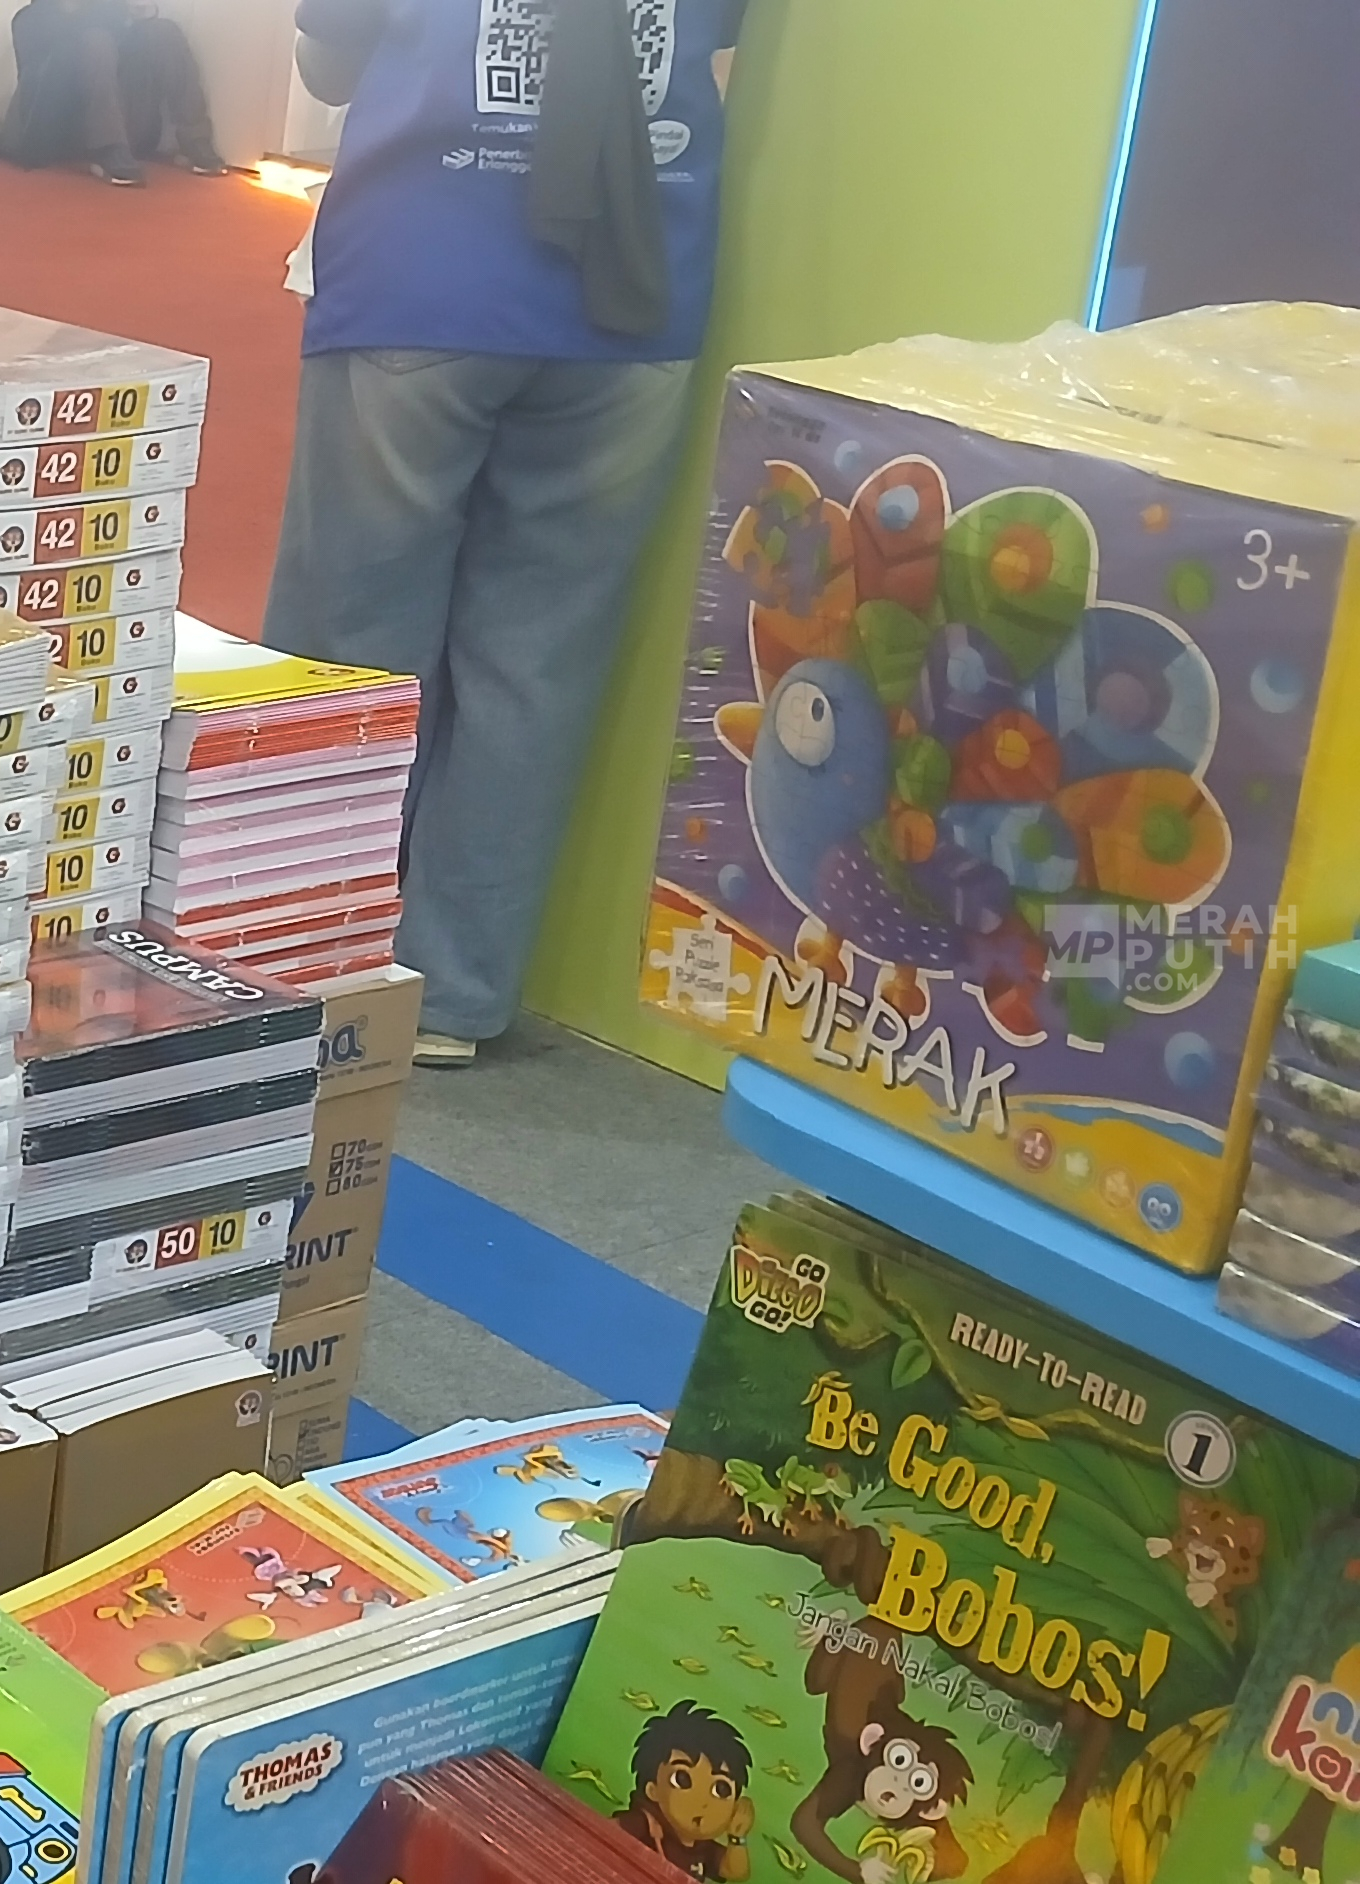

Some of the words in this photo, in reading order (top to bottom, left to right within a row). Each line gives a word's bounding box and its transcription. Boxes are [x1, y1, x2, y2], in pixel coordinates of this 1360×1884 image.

[56, 393, 94, 424] 42
[108, 388, 138, 419] 10
[40, 452, 78, 483] 42
[91, 447, 121, 477] 10
[40, 518, 77, 549] 42
[89, 512, 119, 541] 10
[1236, 529, 1311, 590] 3+
[23, 579, 59, 610] 42
[73, 574, 102, 604] 10
[76, 628, 106, 657] 10
[68, 752, 92, 780] 10
[60, 804, 88, 832] 10
[56, 855, 83, 884] 10
[108, 929, 264, 1001] CAMPUS
[753, 955, 1015, 1135] MERAK
[160, 1226, 196, 1259] 50
[209, 1218, 236, 1247] 10
[284, 1229, 353, 1271] RINT
[796, 1258, 826, 1283] GO
[749, 1301, 791, 1328] GO!
[950, 1312, 1147, 1425] READY-TO-READ
[807, 1380, 880, 1456] Be
[888, 1414, 1057, 1563] Good,
[1182, 1433, 1212, 1477] 1
[869, 1525, 1170, 1732] Bobos!
[787, 1592, 878, 1658] Jangan
[883, 1638, 961, 1698] Nakal
[968, 1680, 1063, 1756] Bobos!
[240, 1741, 332, 1788] THOMAS
[259, 1764, 323, 1796] FRIENDS
